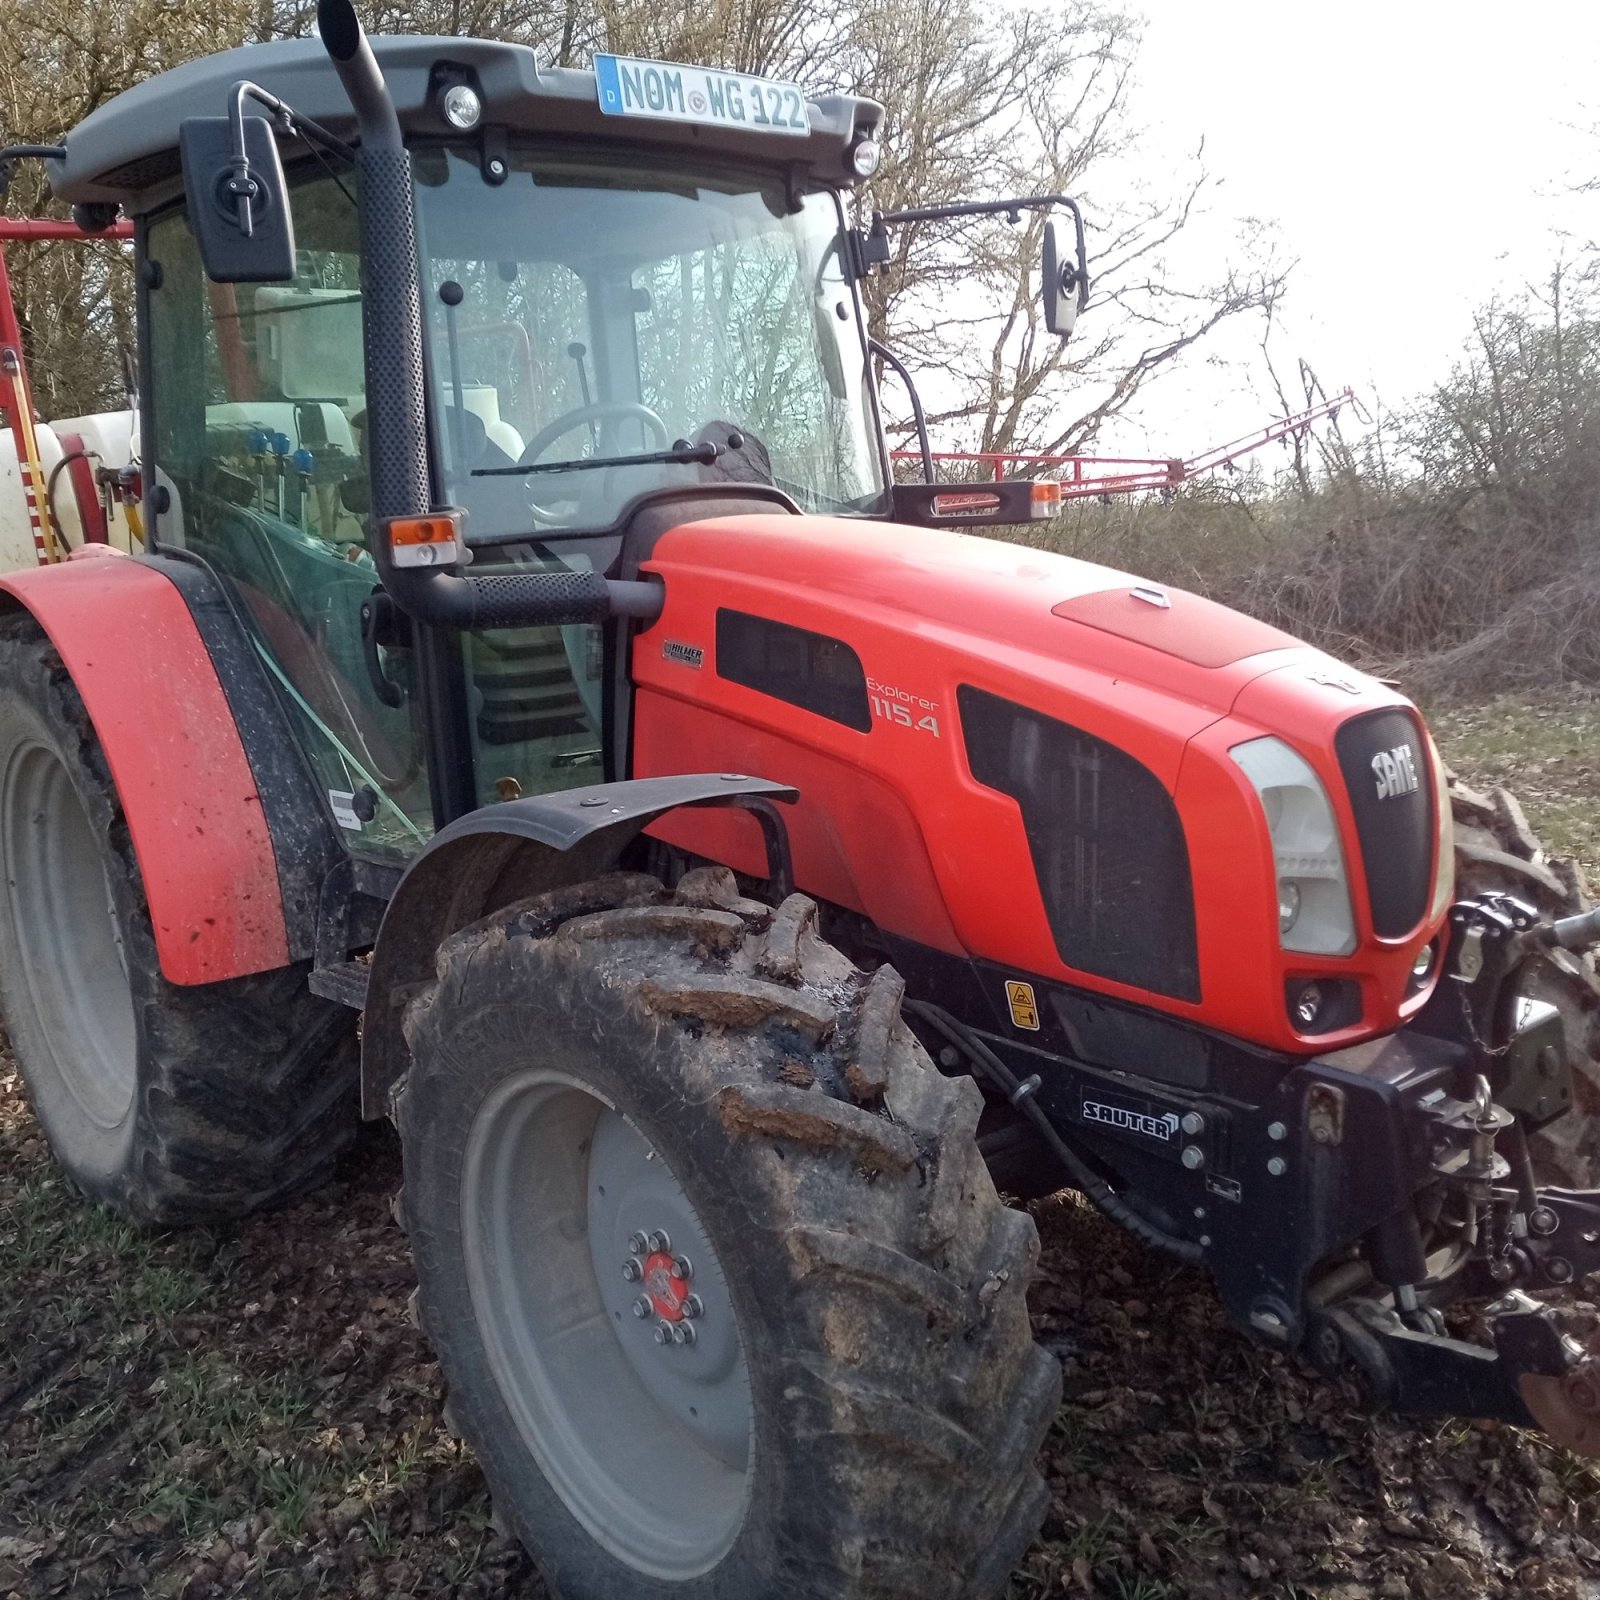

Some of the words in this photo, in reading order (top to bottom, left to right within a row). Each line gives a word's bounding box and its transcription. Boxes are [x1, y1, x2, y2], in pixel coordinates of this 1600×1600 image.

[606, 89, 616, 102] D
[620, 64, 686, 113] NOM
[705, 75, 746, 121] WG
[750, 84, 805, 128] 122
[671, 643, 703, 660] HILMER
[866, 676, 940, 711] Explorer
[871, 695, 940, 738] 115.4
[1371, 744, 1419, 800] SAME
[1083, 1100, 1169, 1141] SAUTER
